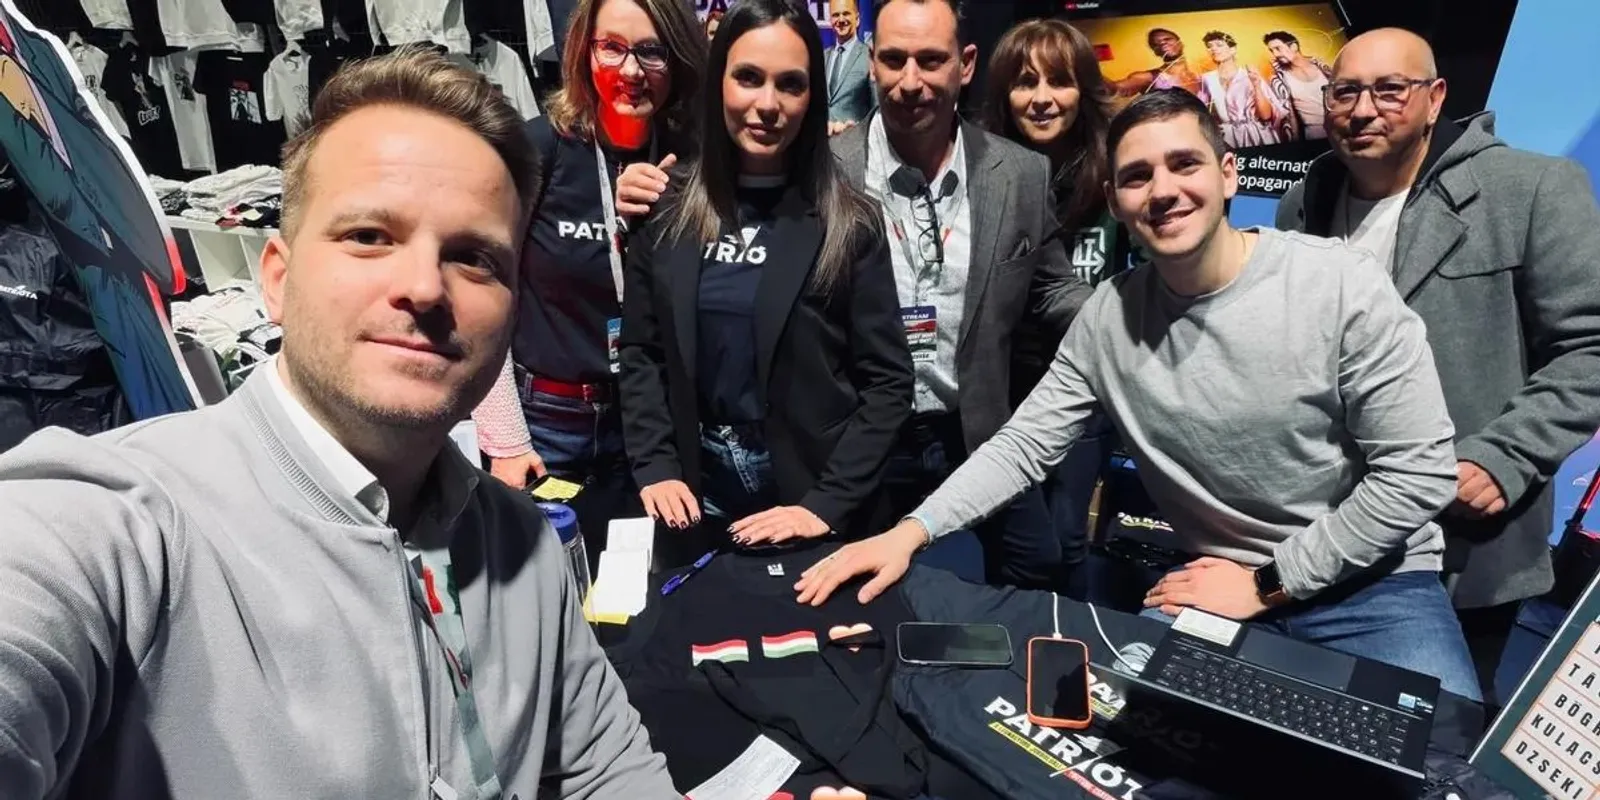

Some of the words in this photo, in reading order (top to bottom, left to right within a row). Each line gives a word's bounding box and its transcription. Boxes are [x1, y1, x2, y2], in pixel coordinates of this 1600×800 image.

[1238, 175, 1303, 192] opagan
[558, 220, 607, 241] PAT
[1531, 713, 1600, 775] KULACS
[1514, 740, 1583, 800] DZSEKI
